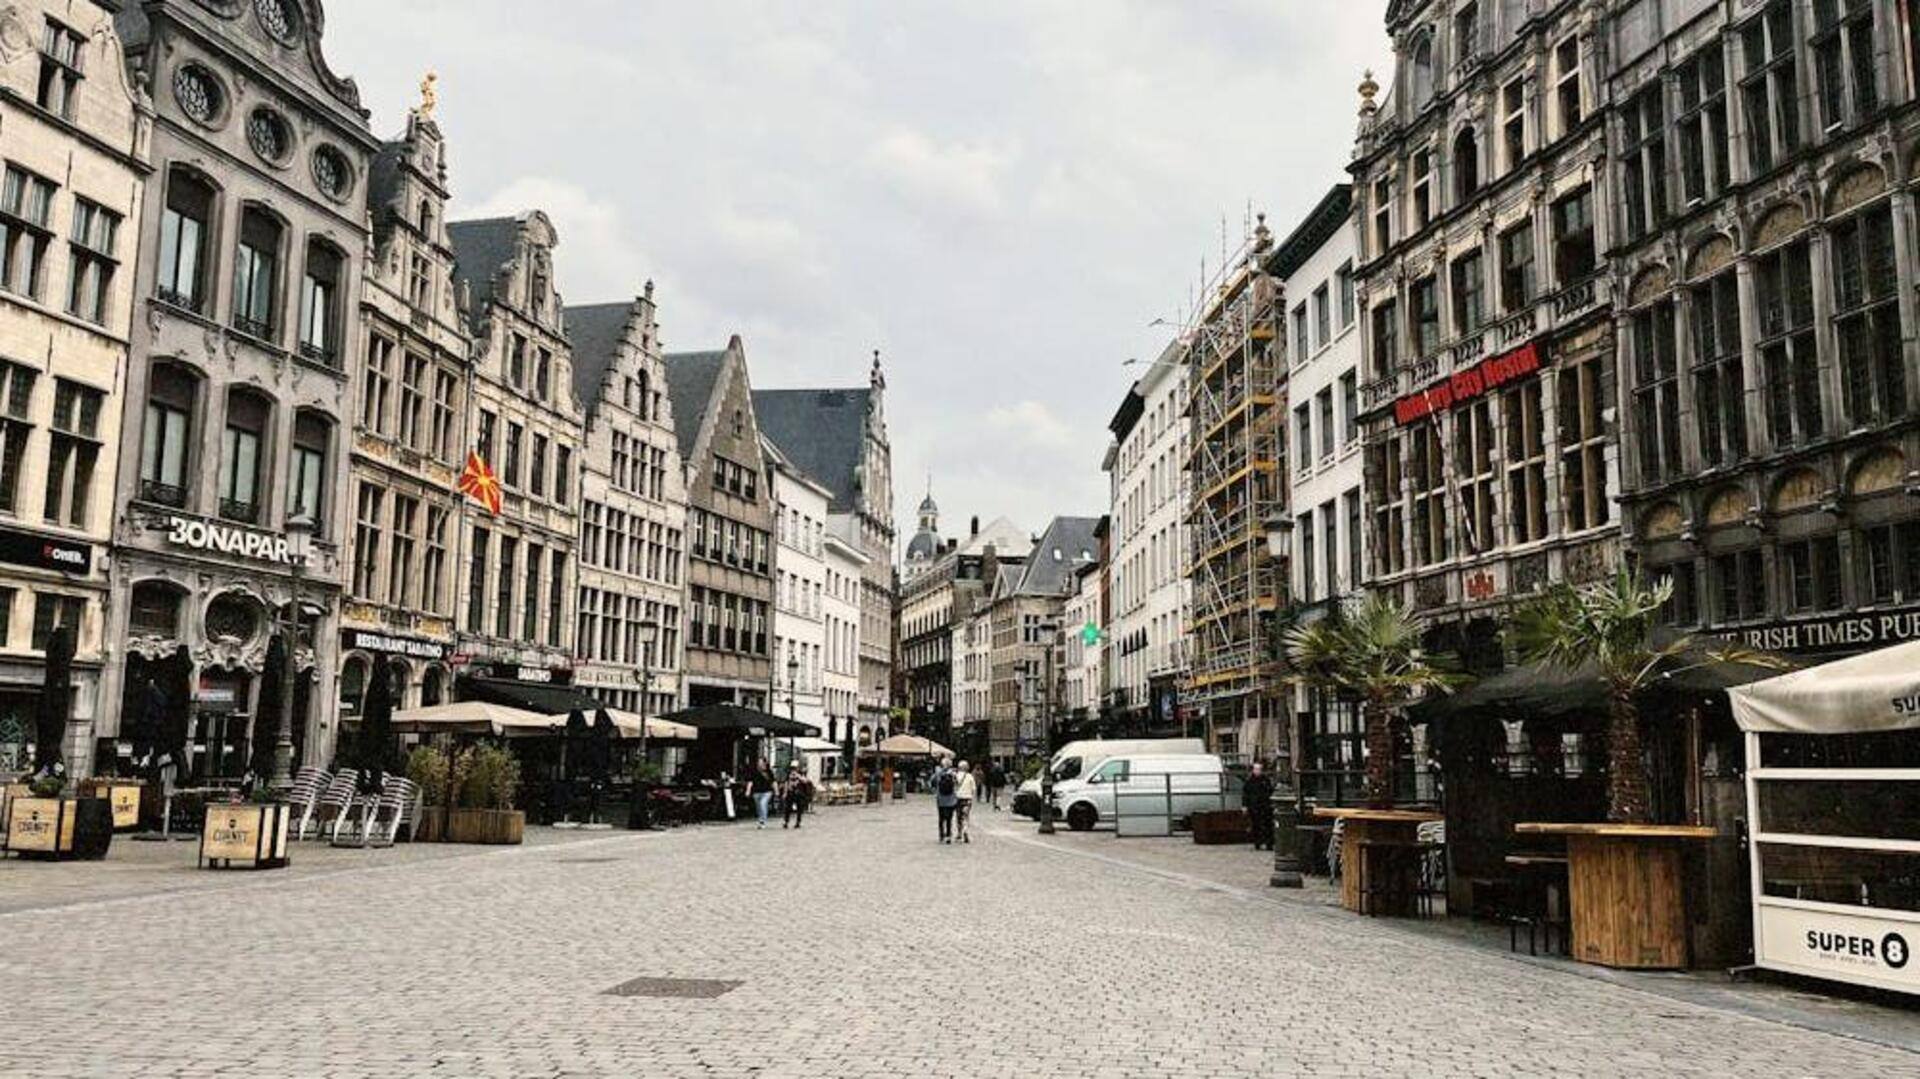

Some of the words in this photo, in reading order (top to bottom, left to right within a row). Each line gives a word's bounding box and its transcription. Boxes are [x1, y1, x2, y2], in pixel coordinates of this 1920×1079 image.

[1482, 342, 1538, 386] Hostel
[168, 516, 319, 567] BONAPARE
[1743, 626, 1798, 650] IRISH
[1804, 619, 1874, 646] TIMES
[1807, 931, 1875, 957] SUPER
